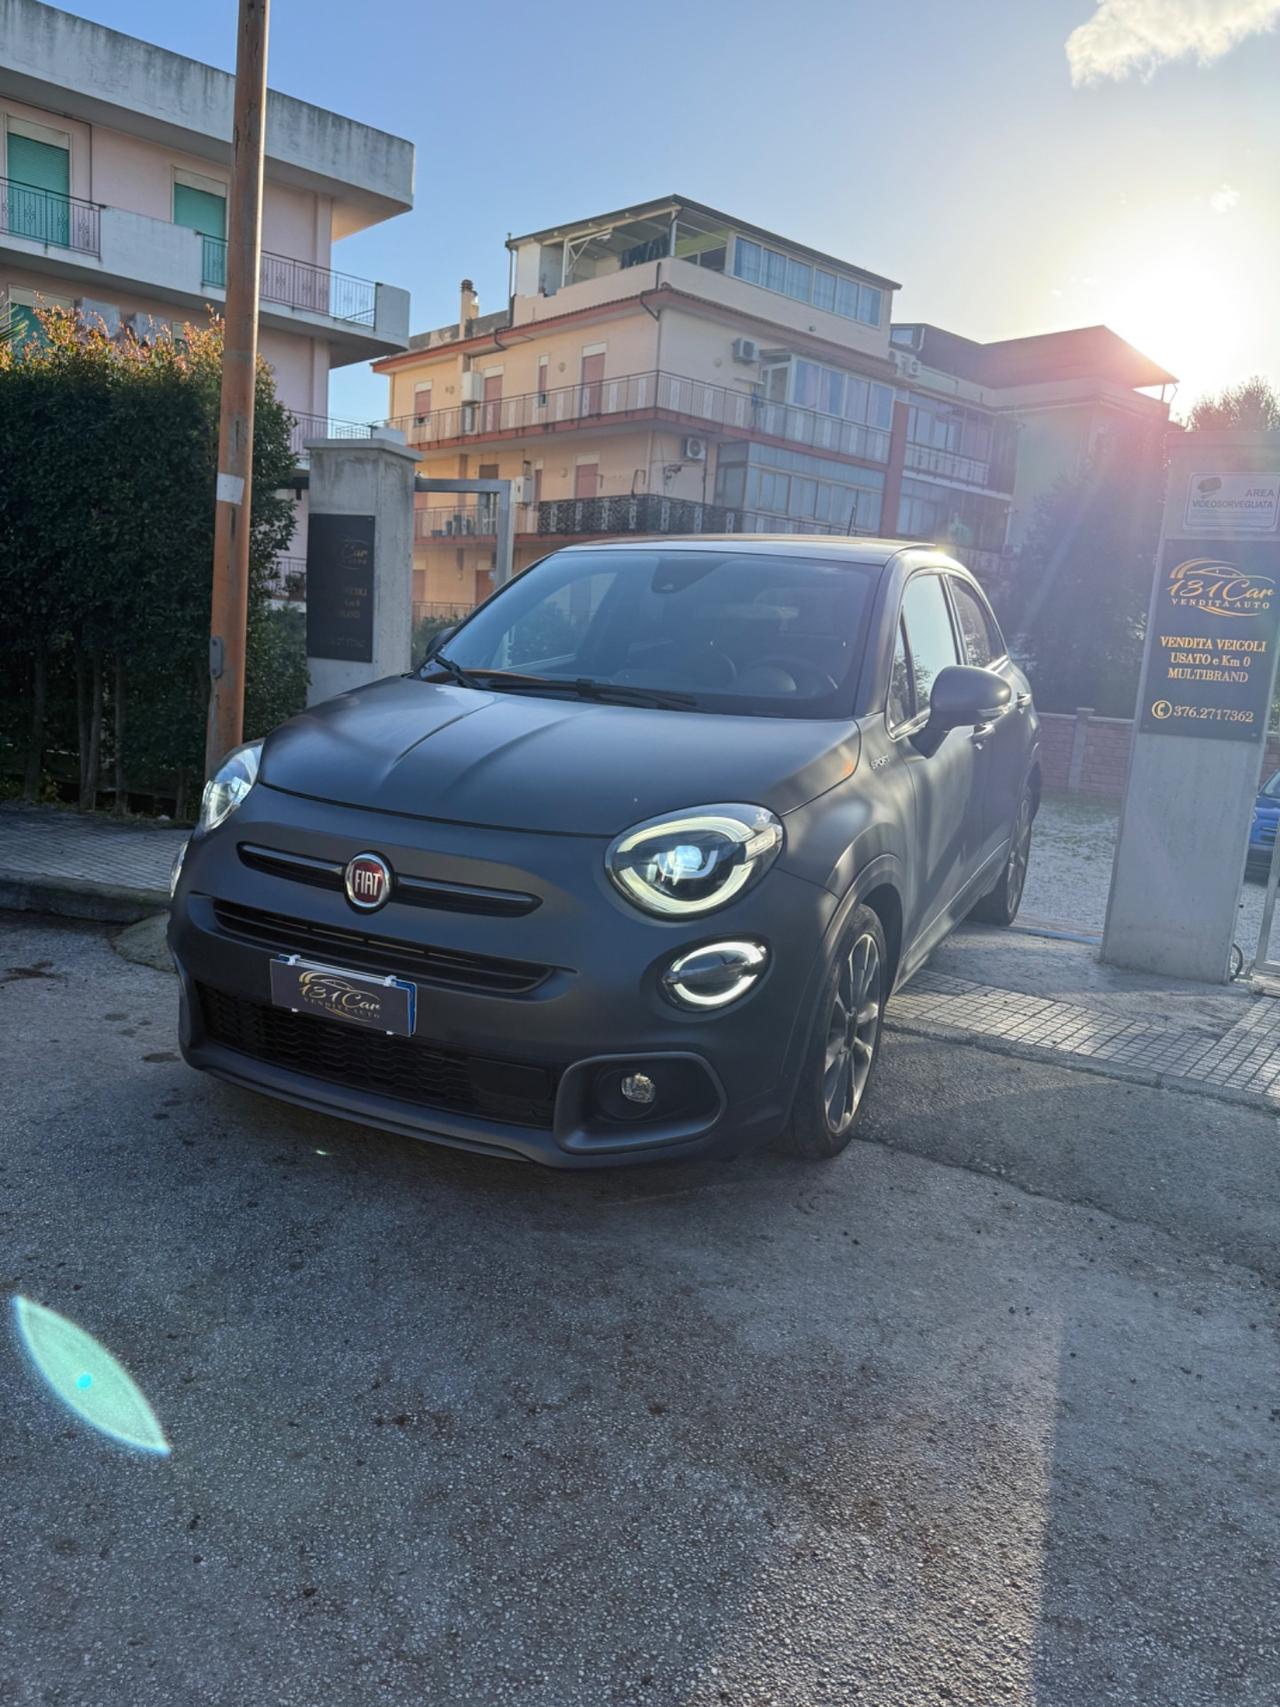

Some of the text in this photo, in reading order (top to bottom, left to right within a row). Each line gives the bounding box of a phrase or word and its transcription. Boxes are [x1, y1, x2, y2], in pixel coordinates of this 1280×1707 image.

[1246, 488, 1275, 497] AREA
[1171, 598, 1229, 607] VENDITA
[1160, 636, 1267, 652] VENDITA VEICOLI
[1170, 652, 1210, 665] USATO
[1221, 655, 1240, 667] Km
[1243, 656, 1251, 667] 0
[1168, 667, 1249, 683] MULTIBRAND
[1174, 705, 1254, 722] 376.2717362
[355, 869, 381, 896] FIAT
